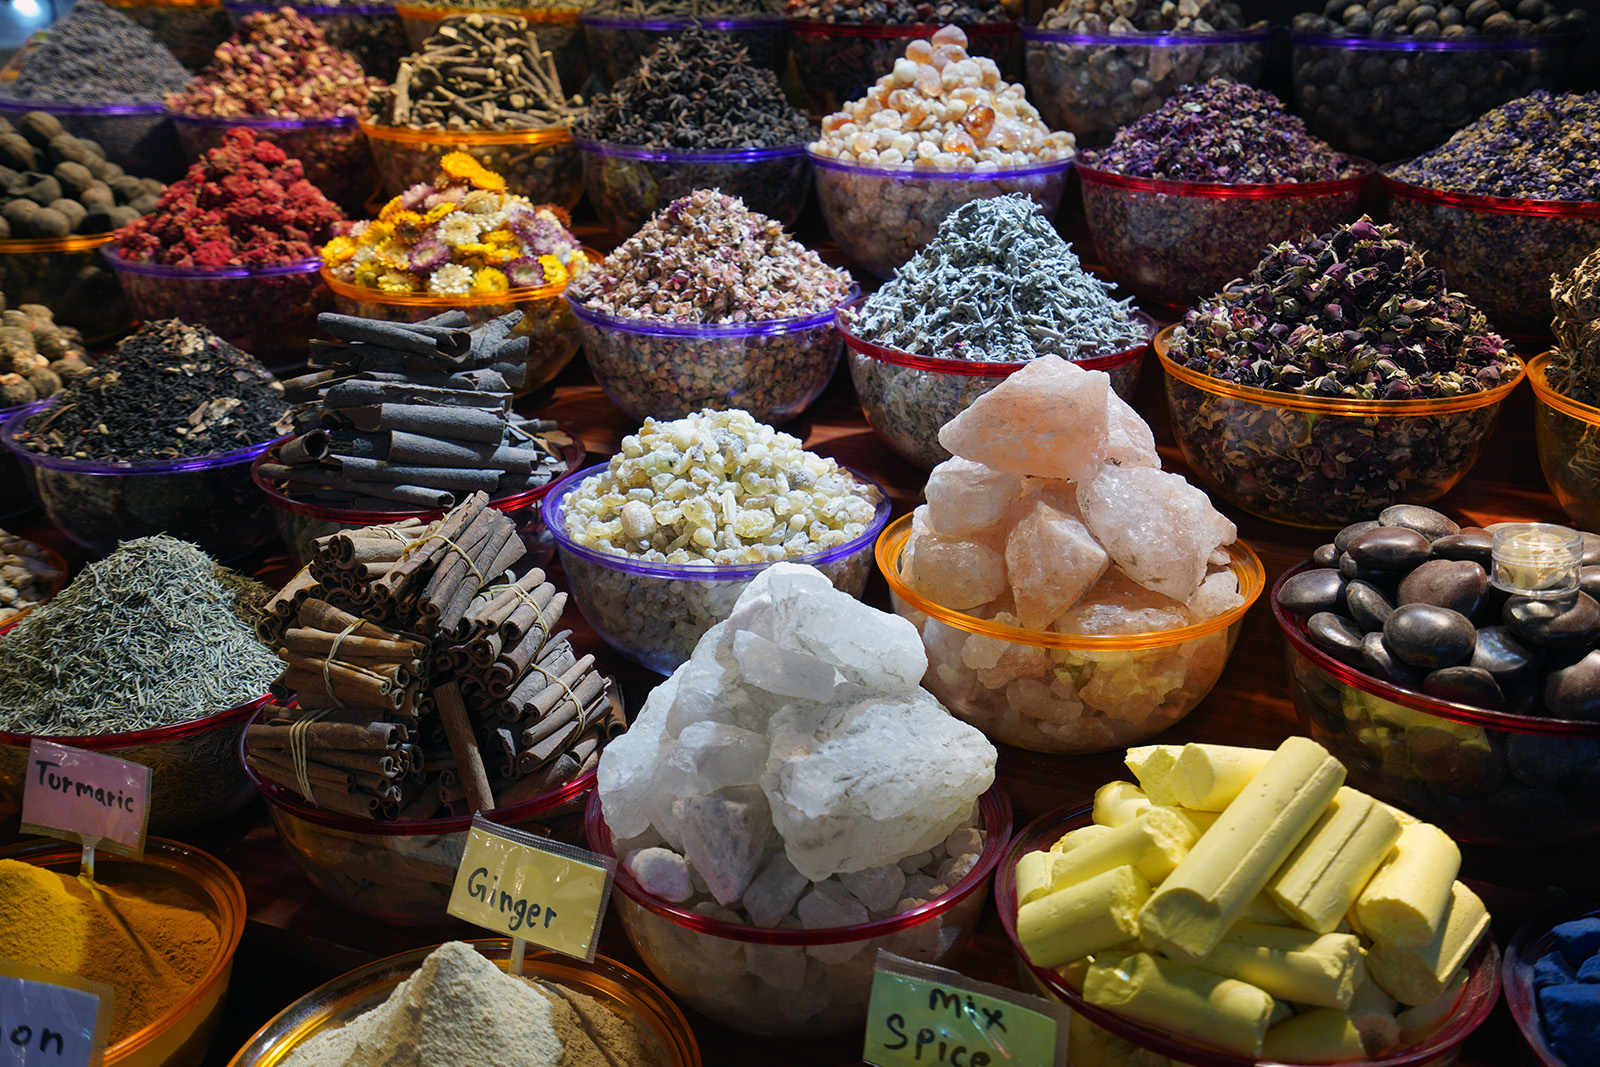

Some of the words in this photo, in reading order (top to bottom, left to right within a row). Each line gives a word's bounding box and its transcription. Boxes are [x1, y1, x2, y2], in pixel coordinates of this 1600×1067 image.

[36, 760, 135, 813] Turmaric
[467, 867, 557, 931] Ginger
[0, 1024, 64, 1056] on
[883, 1014, 991, 1067] Spice
